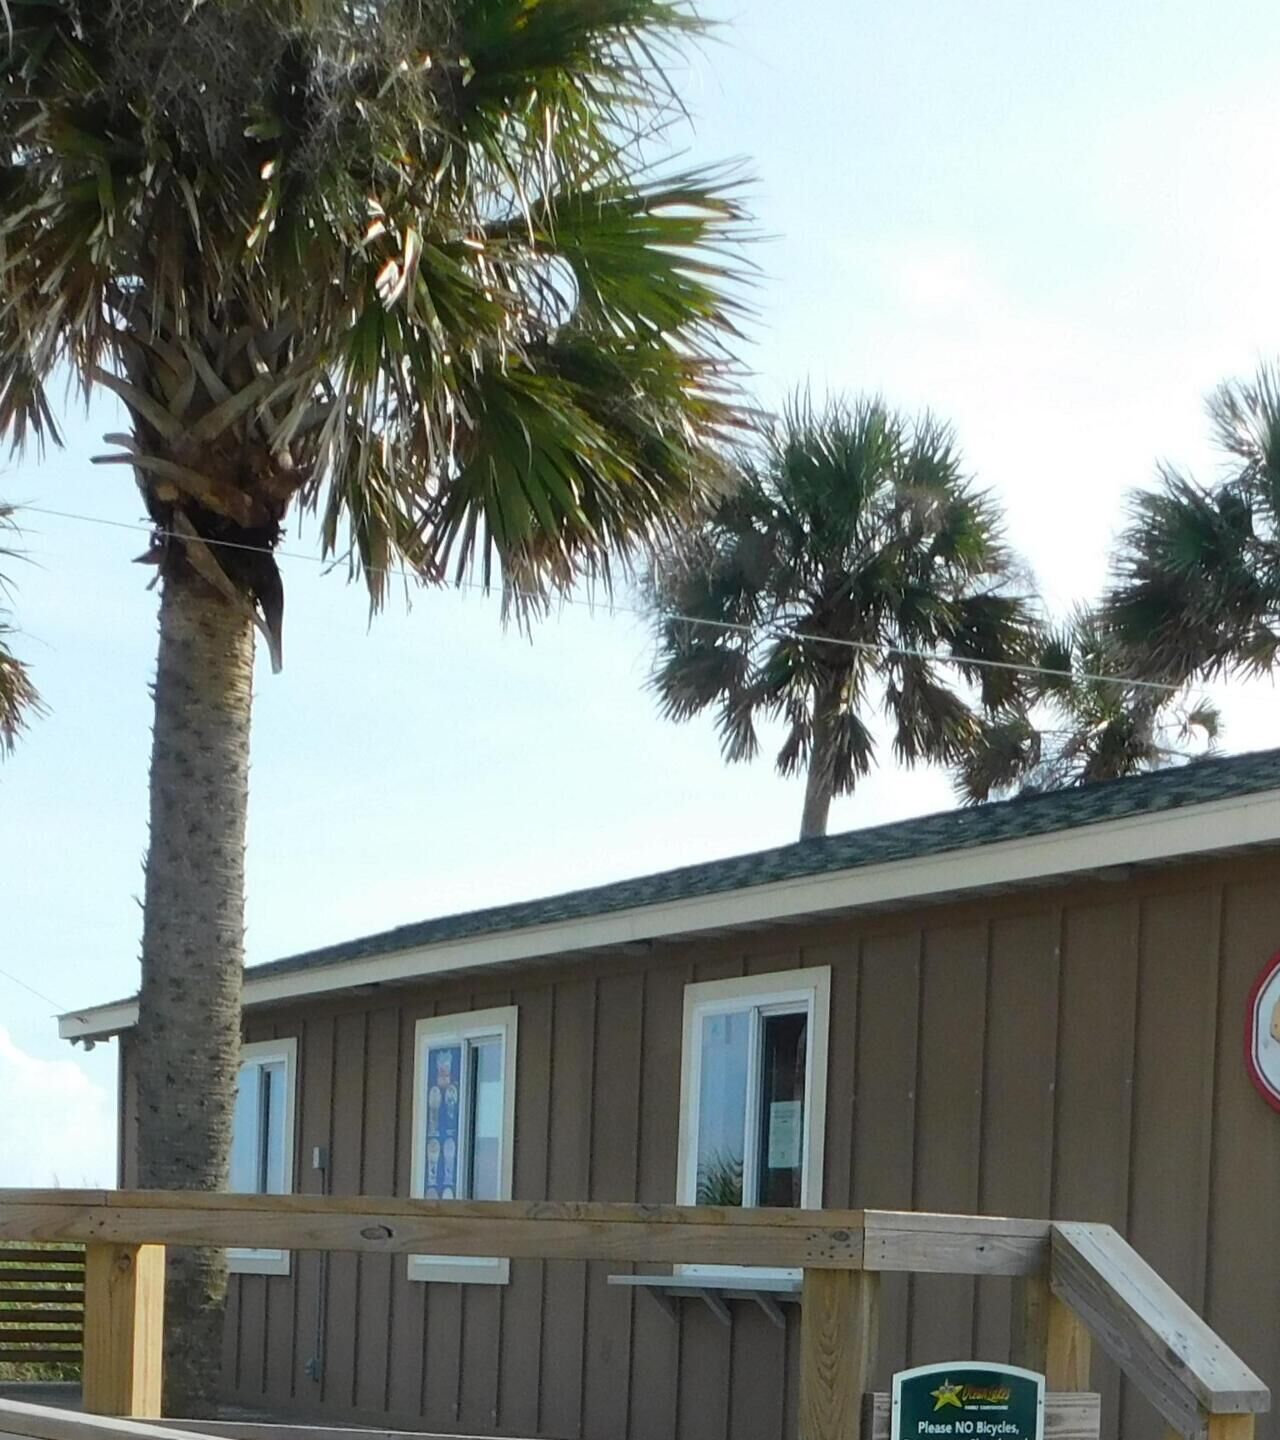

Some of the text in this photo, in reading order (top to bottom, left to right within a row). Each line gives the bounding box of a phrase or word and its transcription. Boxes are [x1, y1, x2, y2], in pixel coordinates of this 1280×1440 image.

[918, 1420, 1020, 1437] Please NO Bicycles,
